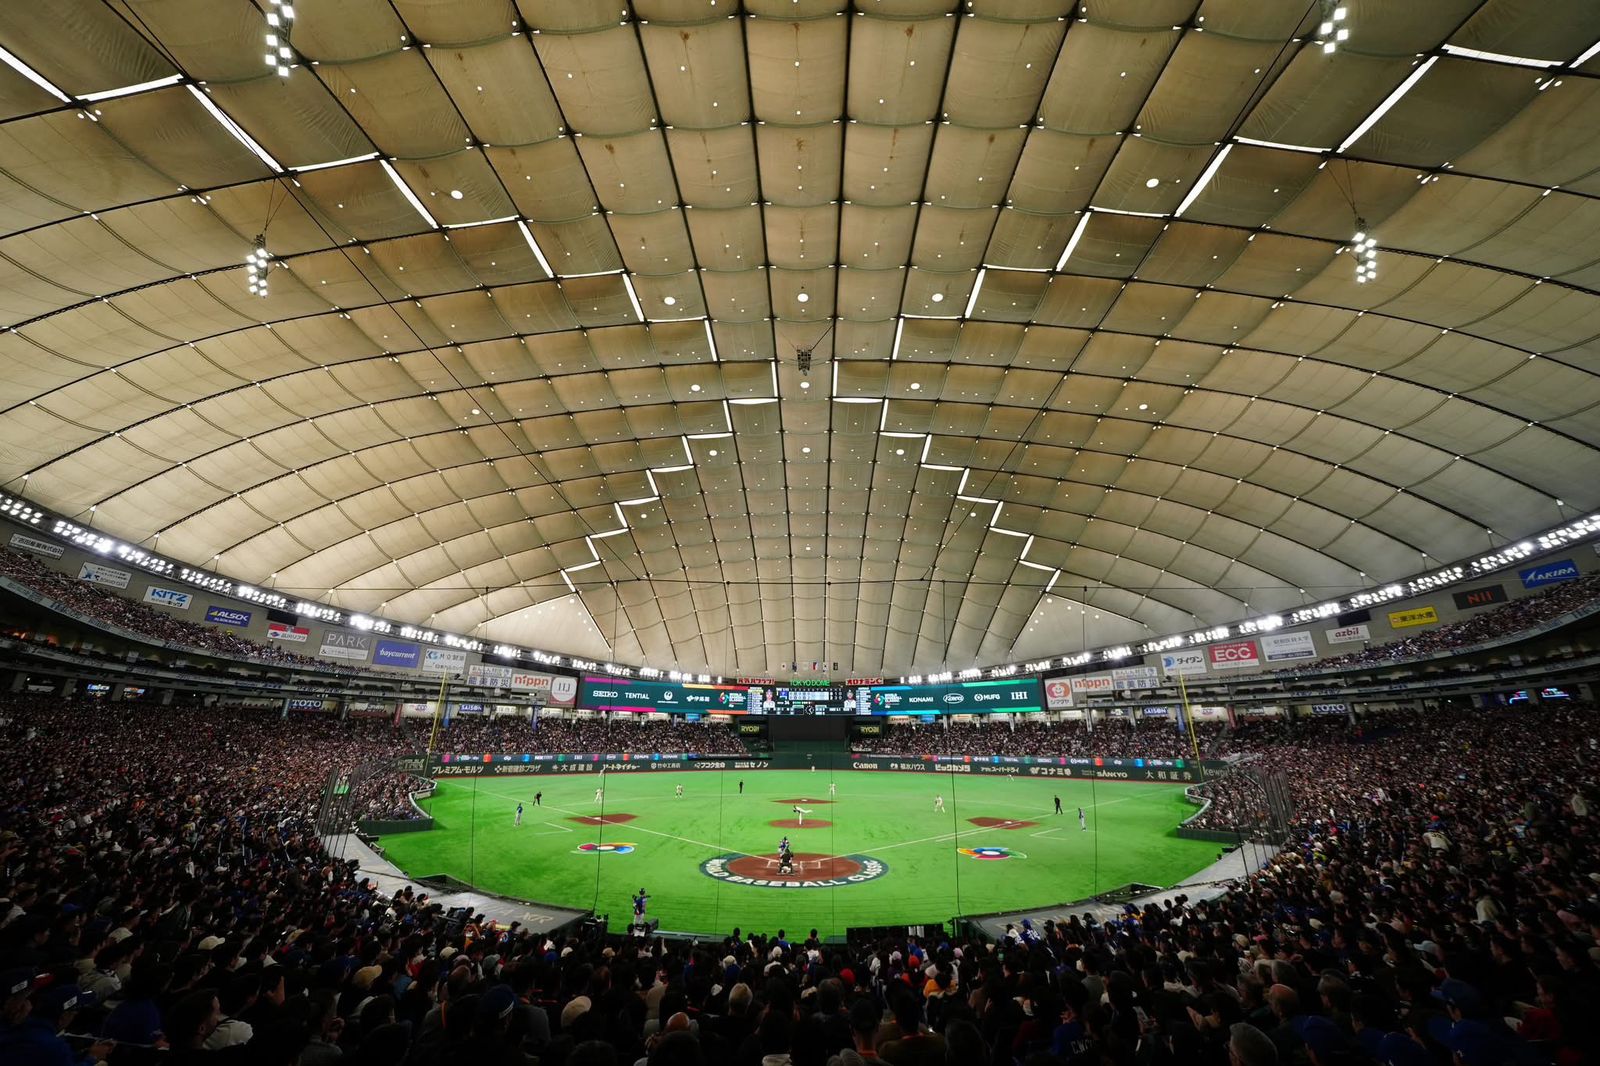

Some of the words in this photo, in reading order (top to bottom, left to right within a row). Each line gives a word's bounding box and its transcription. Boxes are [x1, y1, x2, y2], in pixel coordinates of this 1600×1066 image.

[151, 588, 188, 602] KITZ
[218, 611, 248, 621] ALSOK
[1335, 627, 1360, 638] azbil
[327, 633, 367, 648] PARK
[379, 647, 416, 659] baycurrent
[1214, 646, 1252, 661] ECC
[514, 675, 549, 687] nippn
[1074, 679, 1111, 690] nippn
[593, 690, 618, 698] SEIKO
[625, 692, 650, 700] TENTIAL
[1011, 691, 1028, 700] IHI
[292, 699, 322, 708] TOTO
[1313, 703, 1346, 712] TOTO
[725, 876, 848, 887] BASEBALL
